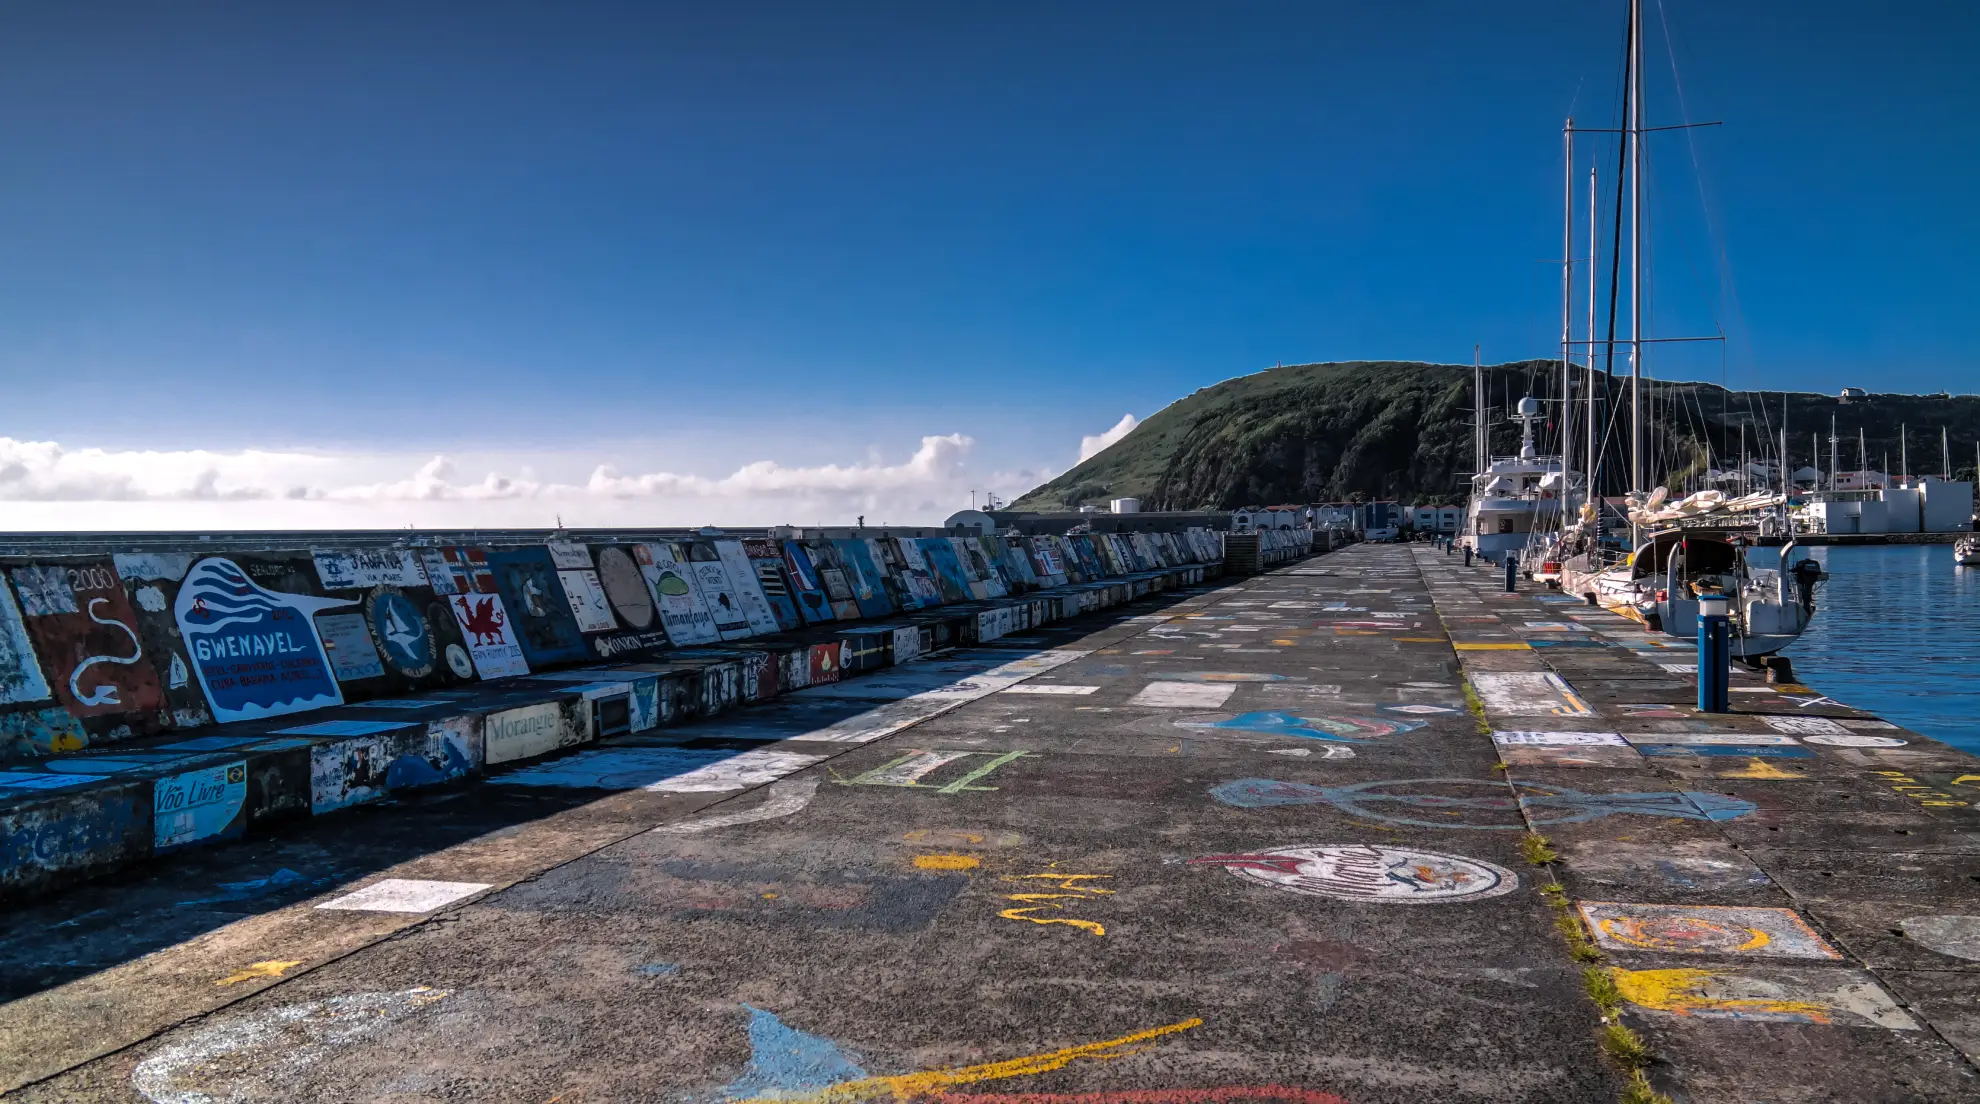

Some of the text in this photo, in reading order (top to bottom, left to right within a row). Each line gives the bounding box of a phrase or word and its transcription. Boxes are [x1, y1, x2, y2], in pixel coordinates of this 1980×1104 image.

[67, 567, 115, 592] 2000
[195, 631, 308, 661] GWENAVEL
[488, 711, 555, 741] Morangie
[188, 780, 225, 805] Livre
